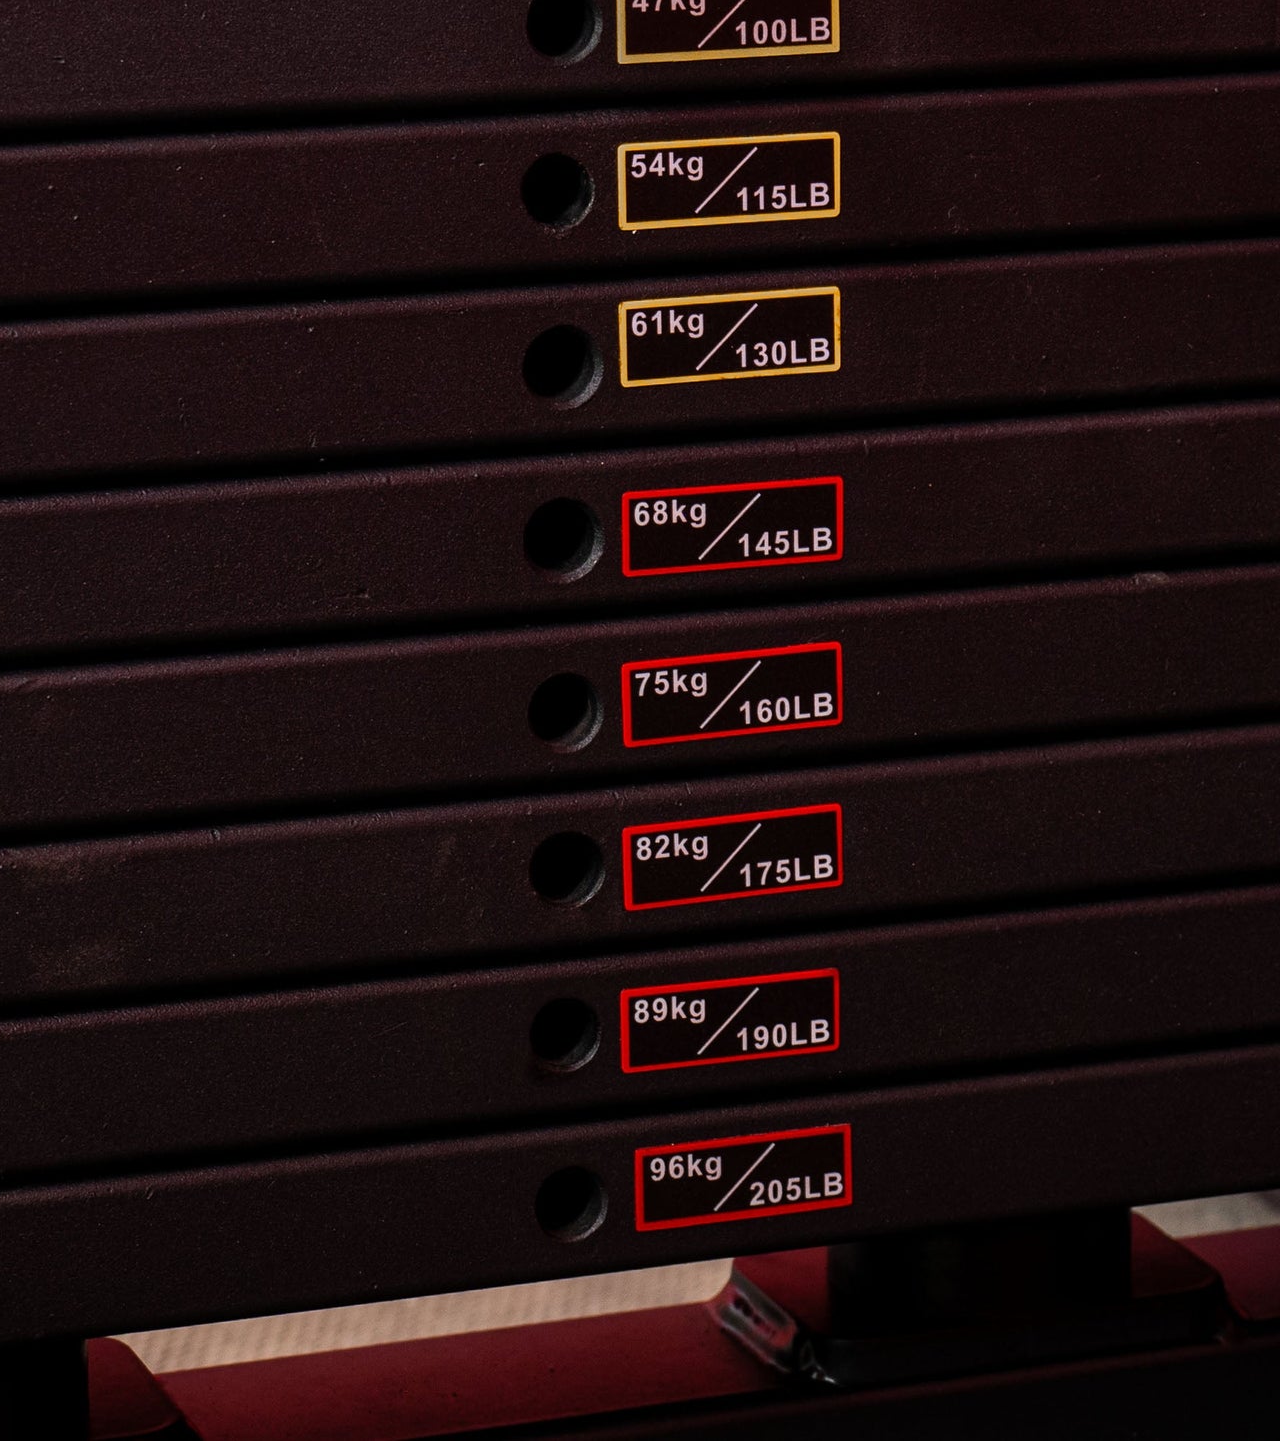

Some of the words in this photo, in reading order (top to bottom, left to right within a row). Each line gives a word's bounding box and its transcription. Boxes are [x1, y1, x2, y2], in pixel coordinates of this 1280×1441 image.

[735, 17, 831, 46] 100LB
[631, 151, 704, 181] 54kg
[736, 182, 830, 211] 115LB
[631, 309, 704, 338] 61kg
[735, 337, 830, 368] 130LB
[634, 499, 707, 528] 68kg
[738, 527, 833, 557] 145LB
[634, 668, 708, 697] 75kg
[739, 692, 834, 725] 160LB
[636, 832, 709, 861] 82kg
[739, 854, 834, 888] 175LB
[634, 995, 706, 1024] 89kg
[736, 1018, 830, 1051] 190LB
[650, 1153, 722, 1182] 96kg
[749, 1172, 843, 1206] 205LB
